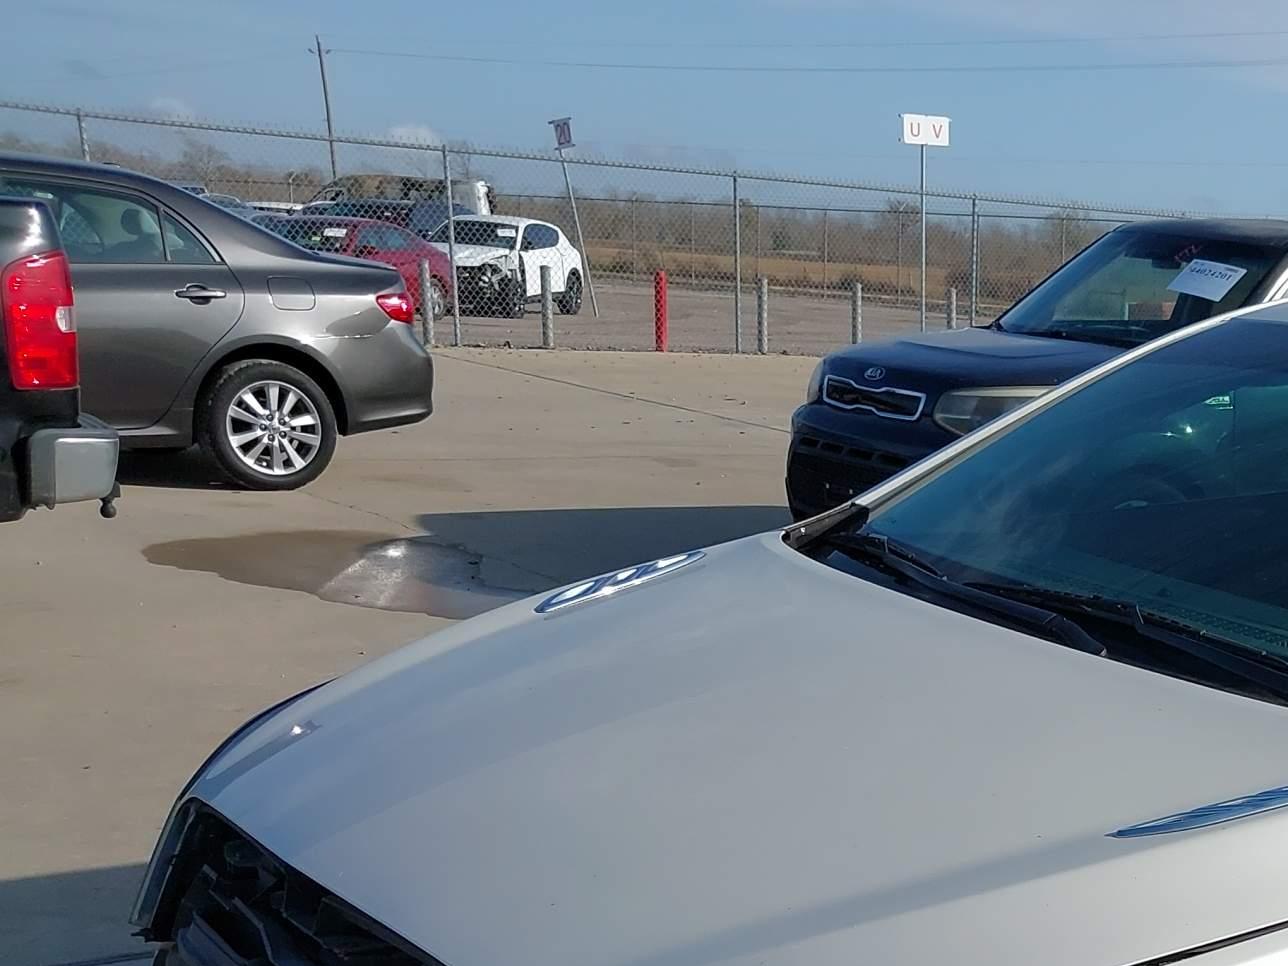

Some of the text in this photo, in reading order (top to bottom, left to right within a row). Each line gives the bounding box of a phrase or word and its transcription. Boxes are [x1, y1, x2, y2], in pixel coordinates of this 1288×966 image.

[555, 121, 571, 145] 20
[910, 122, 942, 139] U V
